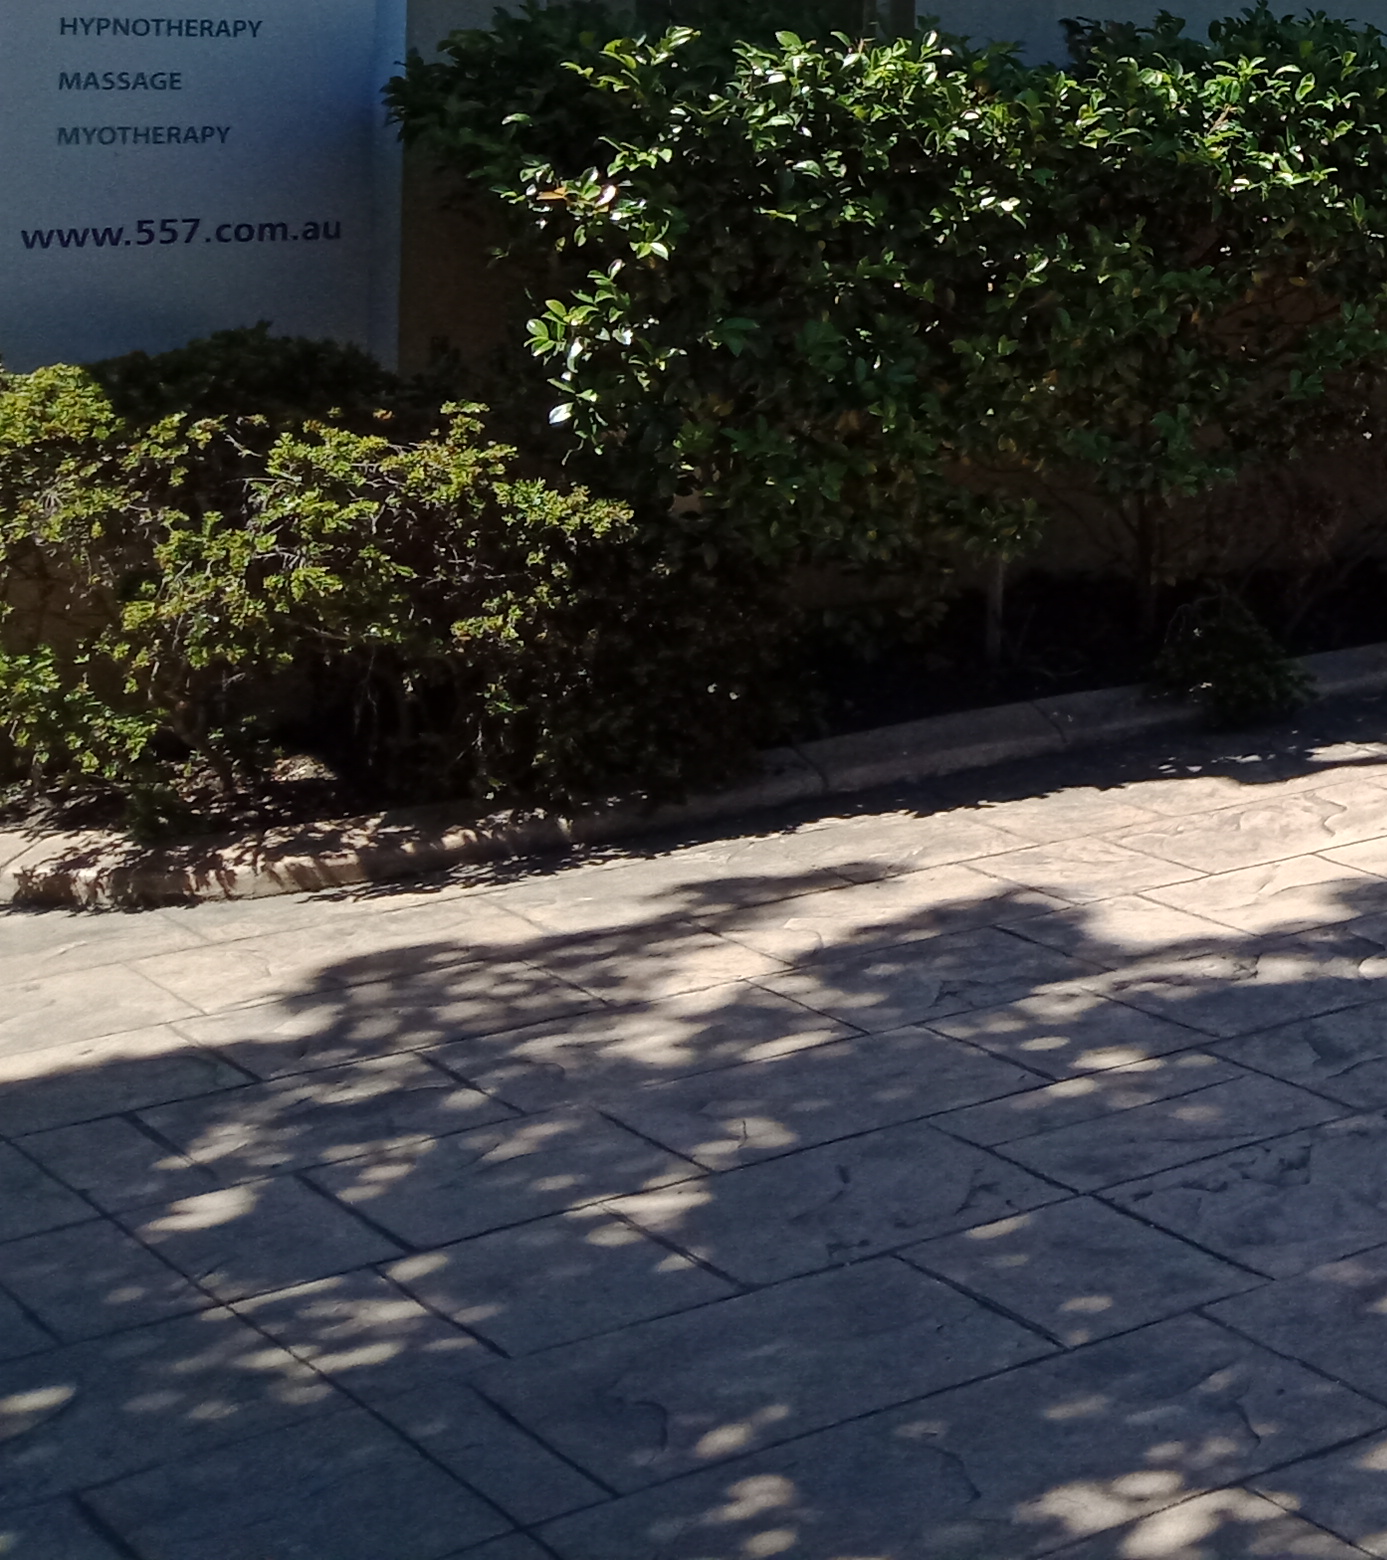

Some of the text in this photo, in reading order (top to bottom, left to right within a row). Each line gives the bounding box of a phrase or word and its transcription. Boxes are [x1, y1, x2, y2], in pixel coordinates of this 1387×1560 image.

[59, 17, 263, 39] HYPNOTHERAPY
[58, 72, 182, 91] MASSAGE
[57, 126, 232, 146] MYOTHERAPY
[21, 218, 341, 249] www.557.com.au
